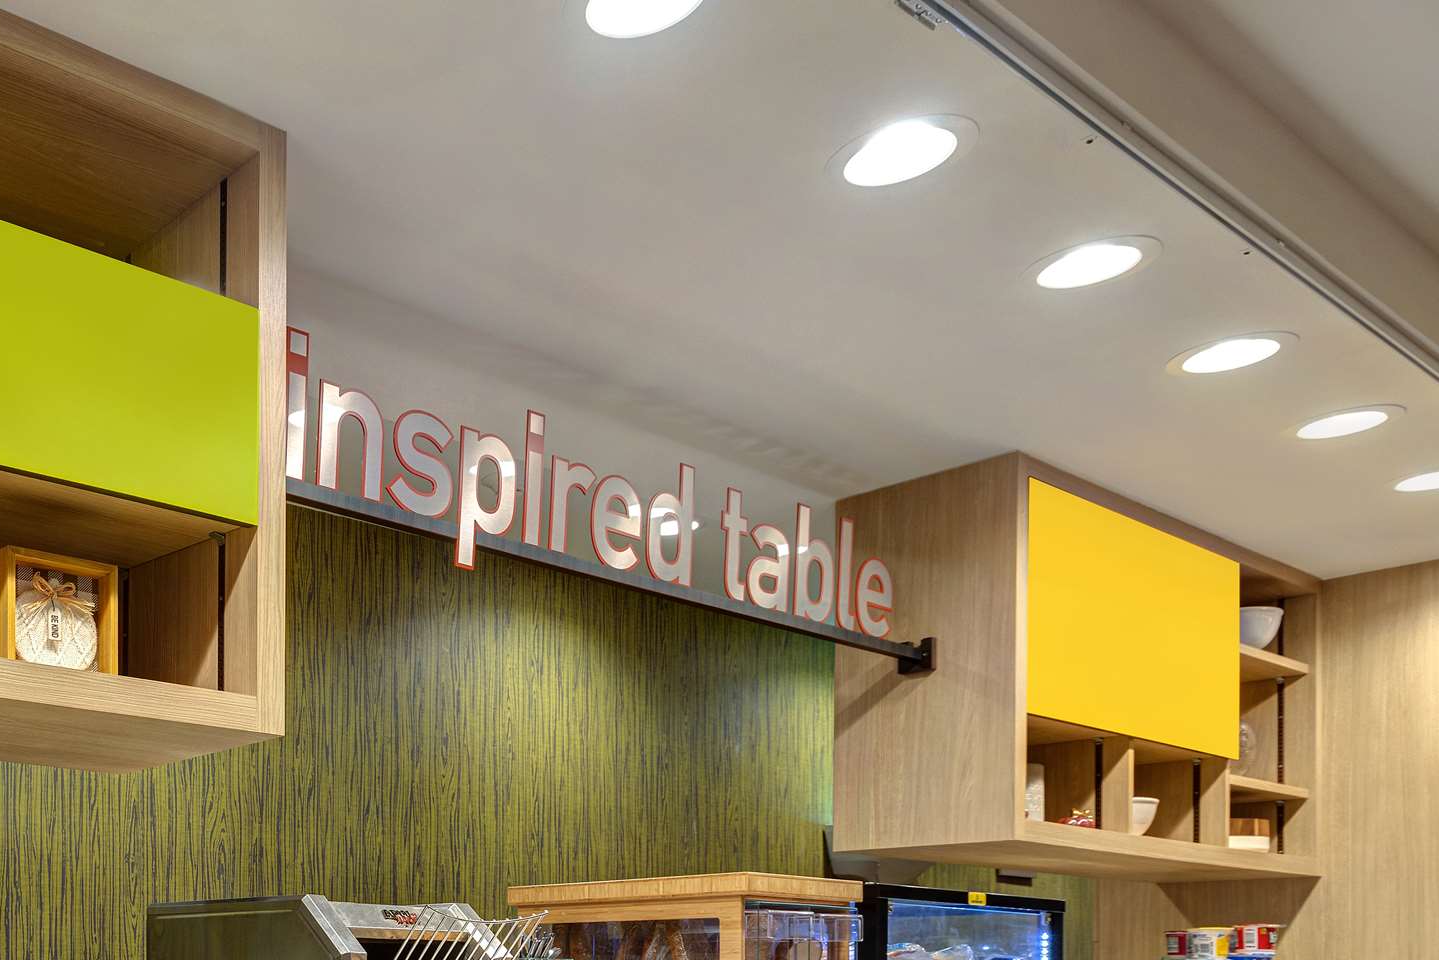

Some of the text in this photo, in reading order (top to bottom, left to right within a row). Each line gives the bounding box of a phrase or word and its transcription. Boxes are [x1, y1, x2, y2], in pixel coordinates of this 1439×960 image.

[286, 326, 892, 639] inspired table
[51, 614, 59, 639] BE KIND
